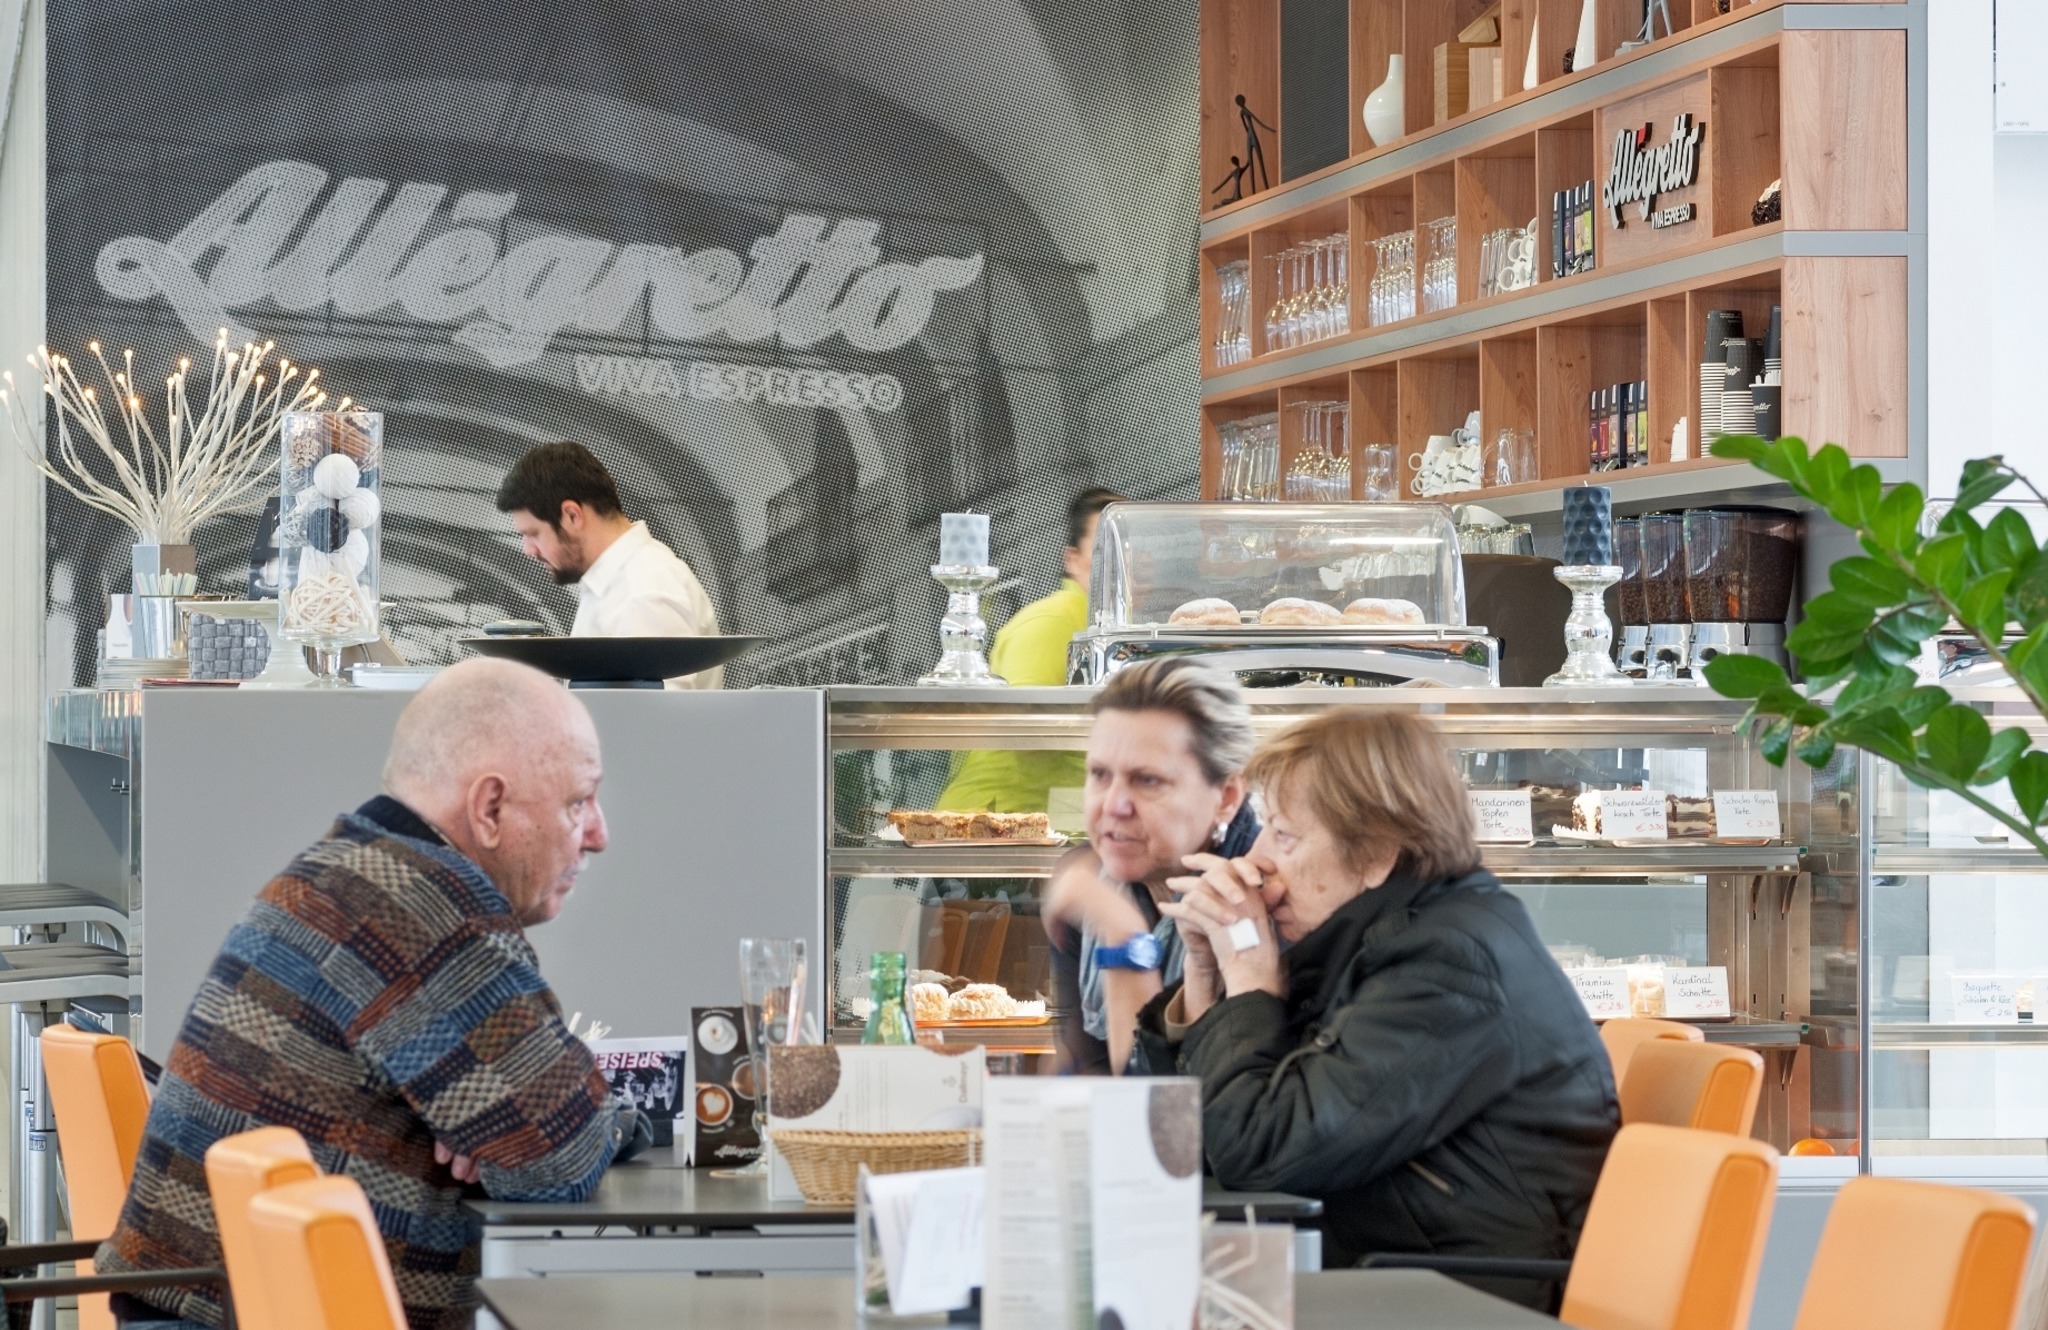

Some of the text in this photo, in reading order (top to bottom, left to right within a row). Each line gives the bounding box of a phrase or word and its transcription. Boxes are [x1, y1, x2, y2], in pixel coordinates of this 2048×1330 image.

[1664, 202, 1690, 226] ESPRESSO
[576, 353, 904, 413] VIVA ESPRESSO
[1480, 808, 1509, 820] Topfen
[1640, 807, 1662, 817] Torte
[1480, 819, 1505, 829] Torte
[1636, 821, 1646, 832] €
[1502, 826, 1512, 837] €
[1571, 973, 1614, 987] Tiramisu
[1672, 973, 1713, 985] Kardinal
[1963, 981, 2002, 994] Baguette
[1582, 989, 1615, 1000] Schnitte
[1596, 1002, 1607, 1012] €
[594, 1051, 664, 1070] SPEISE
